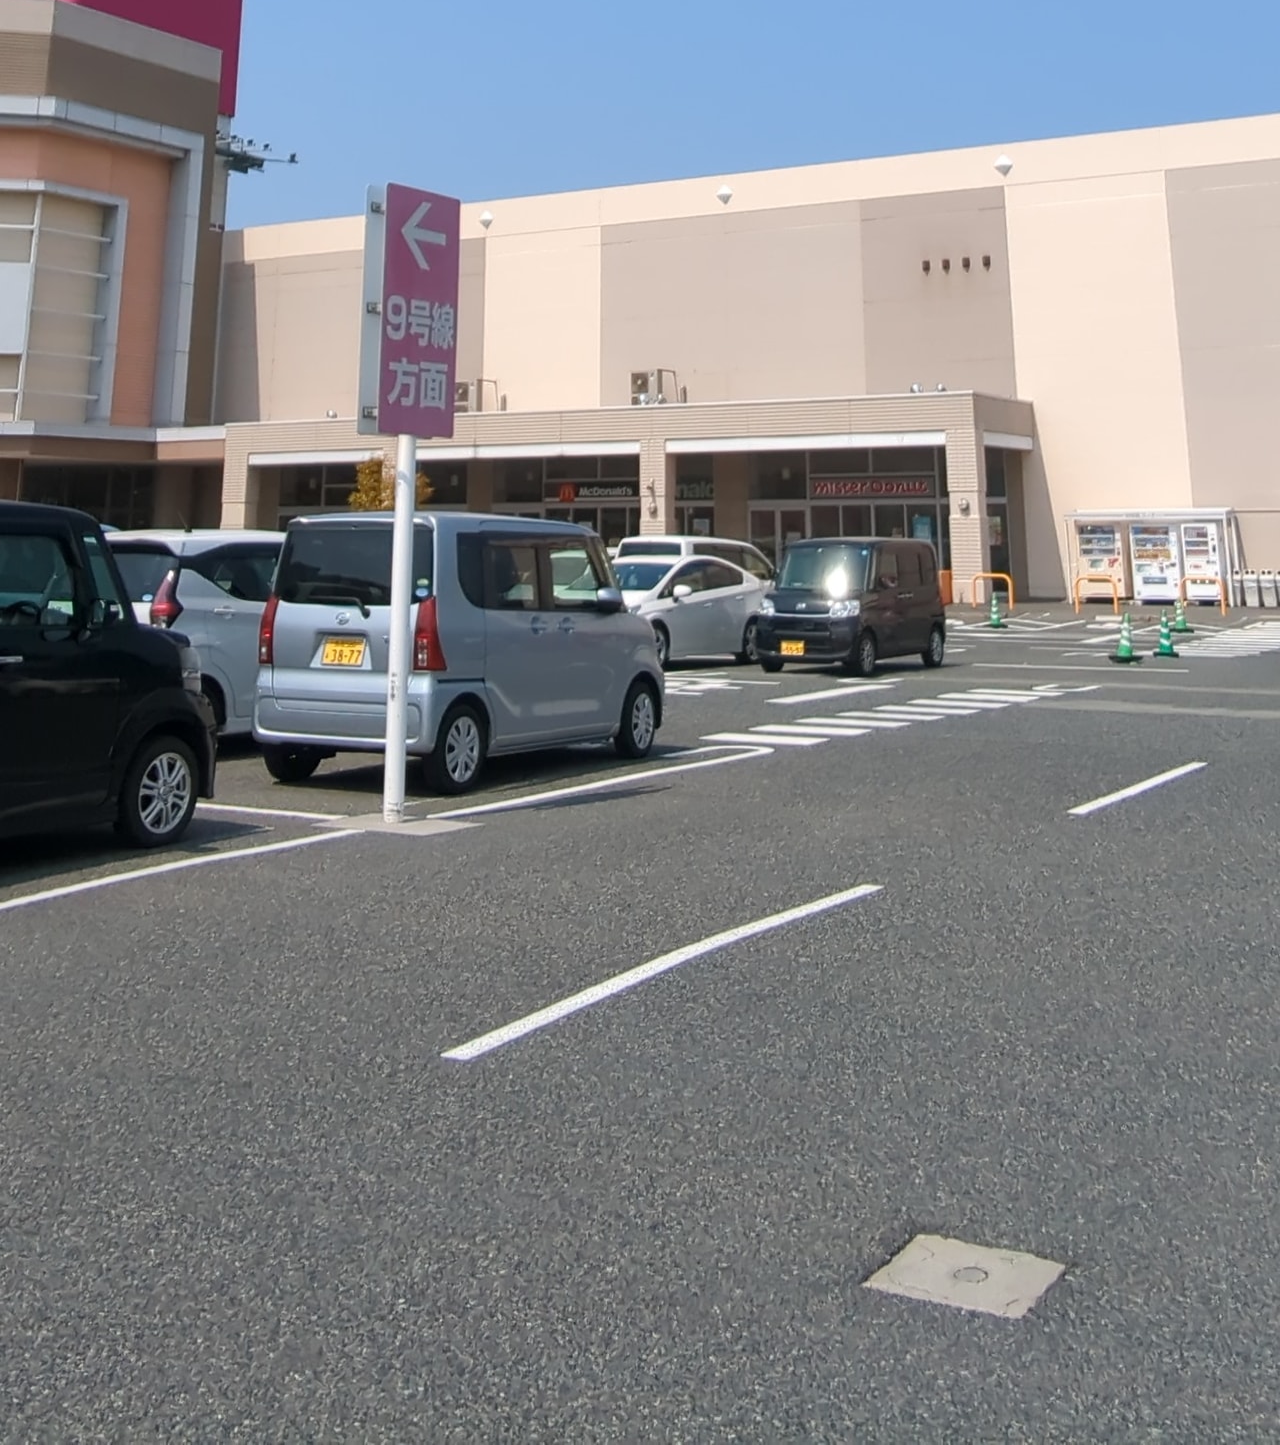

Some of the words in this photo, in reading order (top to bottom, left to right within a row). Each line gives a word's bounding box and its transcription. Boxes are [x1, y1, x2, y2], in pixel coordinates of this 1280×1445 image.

[386, 295, 454, 349] 9号線
[387, 358, 448, 411] 方面
[580, 486, 633, 497] McDonald's
[330, 649, 362, 663] 38-77
